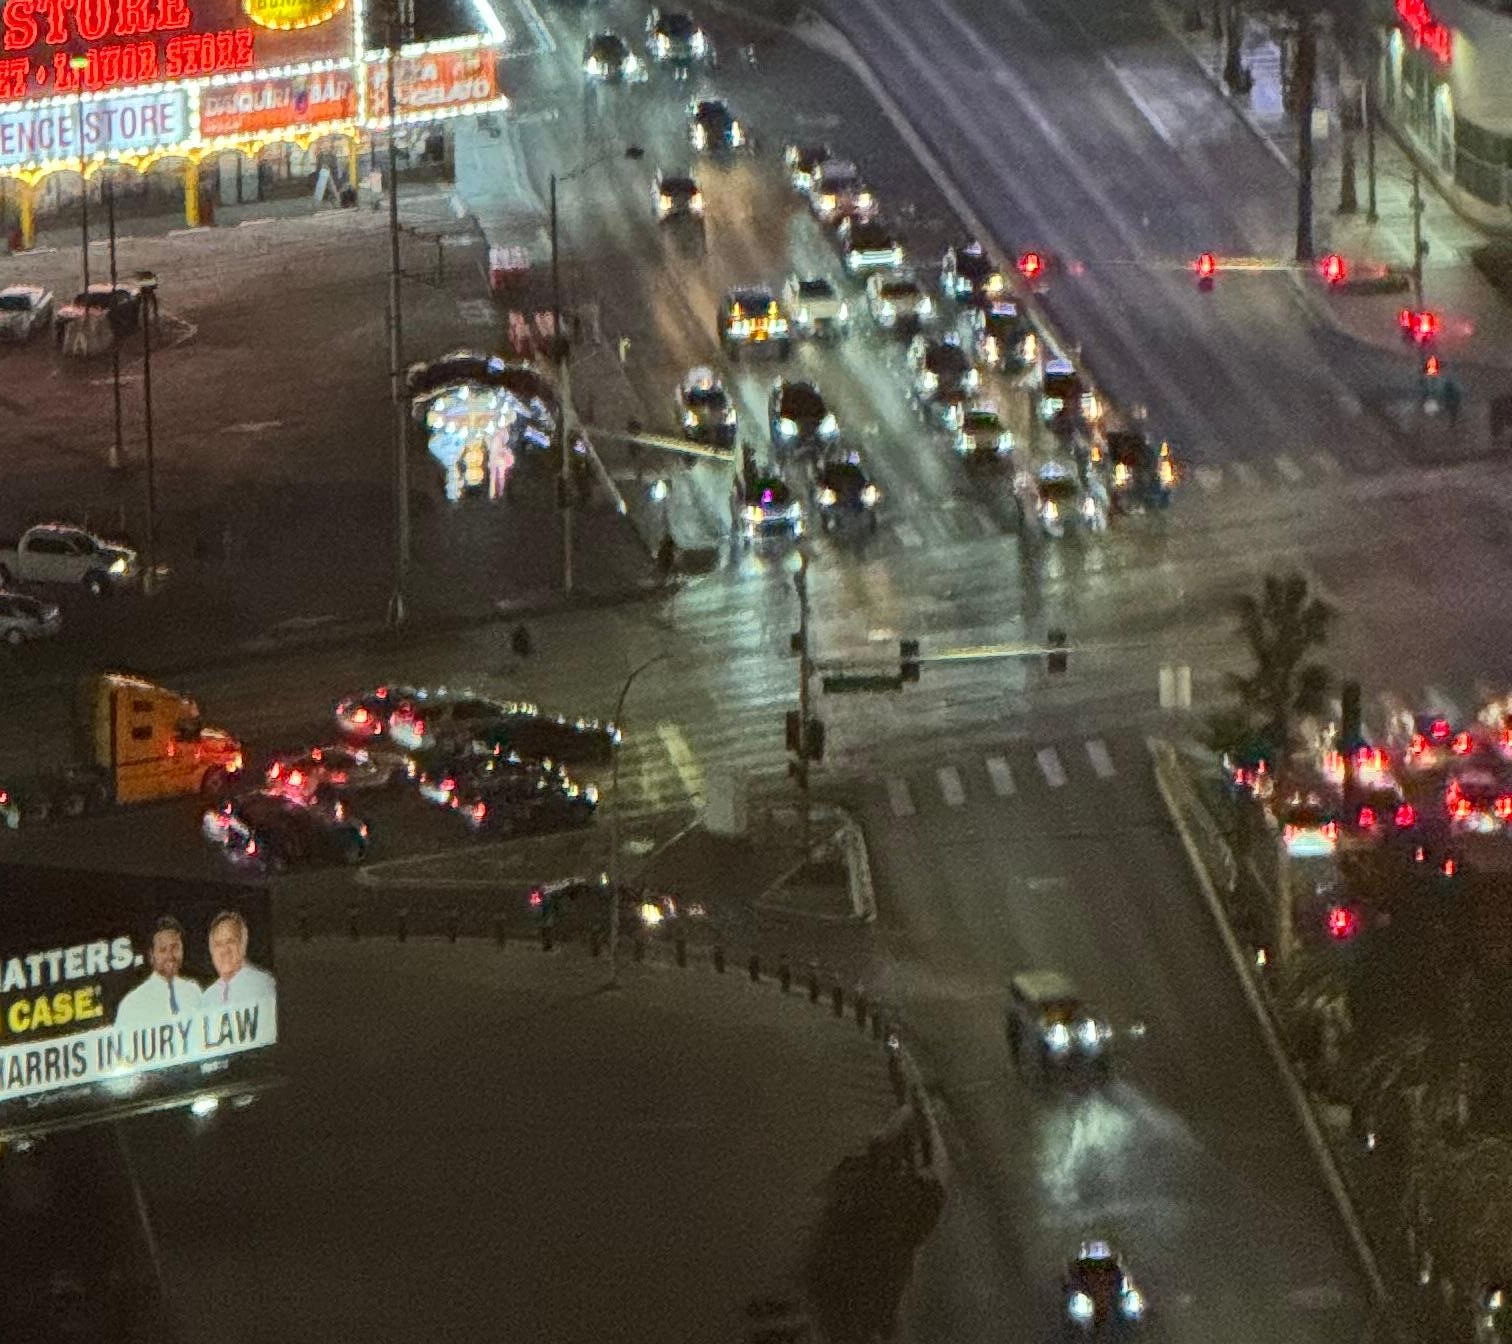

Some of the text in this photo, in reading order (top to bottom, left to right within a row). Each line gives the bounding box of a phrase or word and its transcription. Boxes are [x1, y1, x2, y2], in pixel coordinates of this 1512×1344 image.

[52, 40, 159, 93] LIQUOR
[164, 26, 255, 78] STORE
[82, 102, 178, 144] STORE
[97, 1015, 195, 1071] INJURY
[203, 1004, 261, 1050] LAW
